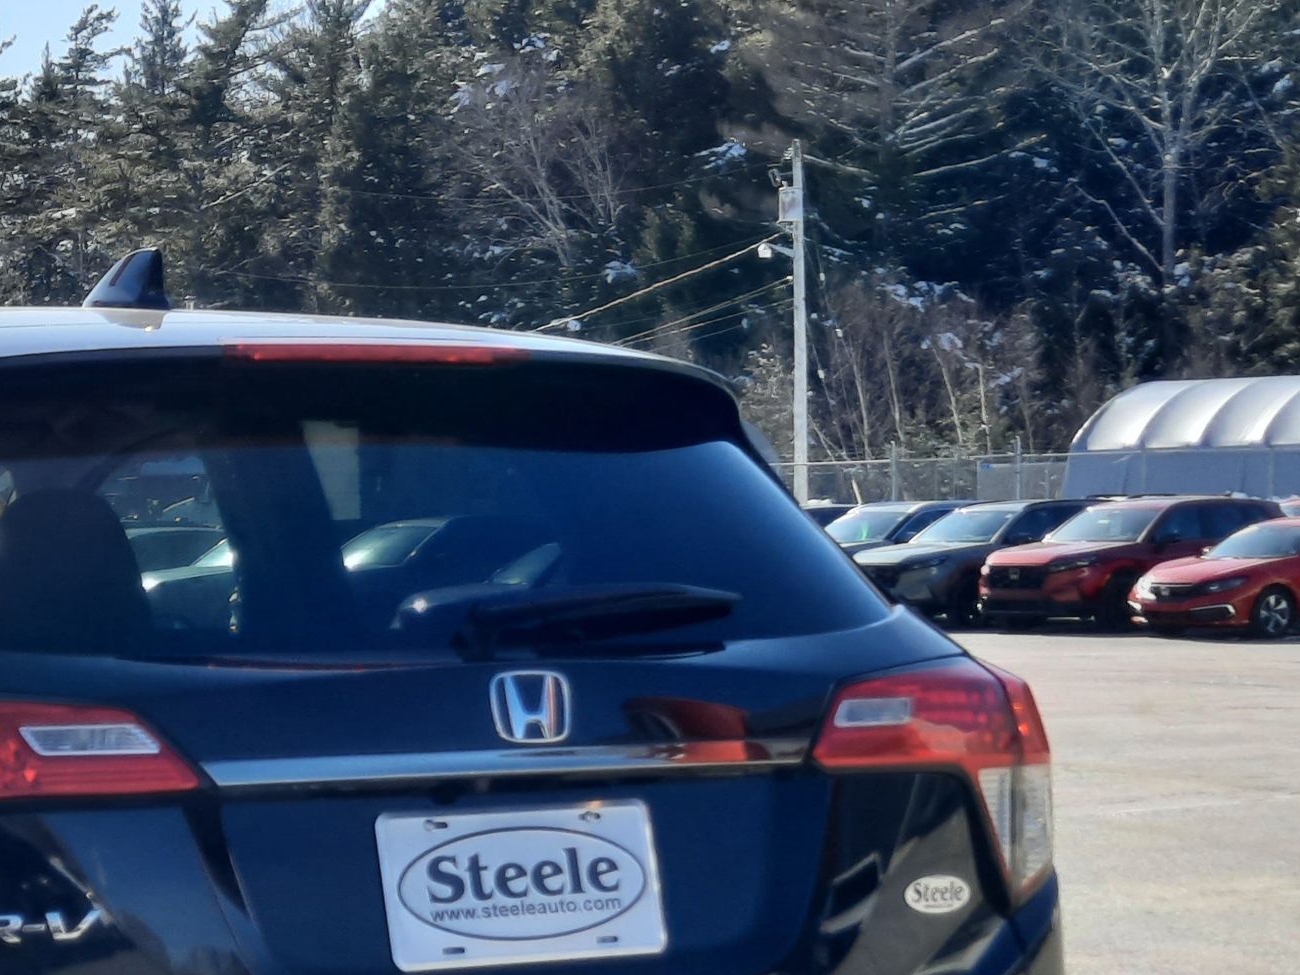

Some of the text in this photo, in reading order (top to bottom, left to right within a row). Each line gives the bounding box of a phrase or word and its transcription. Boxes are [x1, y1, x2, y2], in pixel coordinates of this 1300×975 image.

[425, 847, 620, 904] Steele
[911, 880, 964, 903] Steele
[430, 897, 622, 922] www.steeleauto.com
